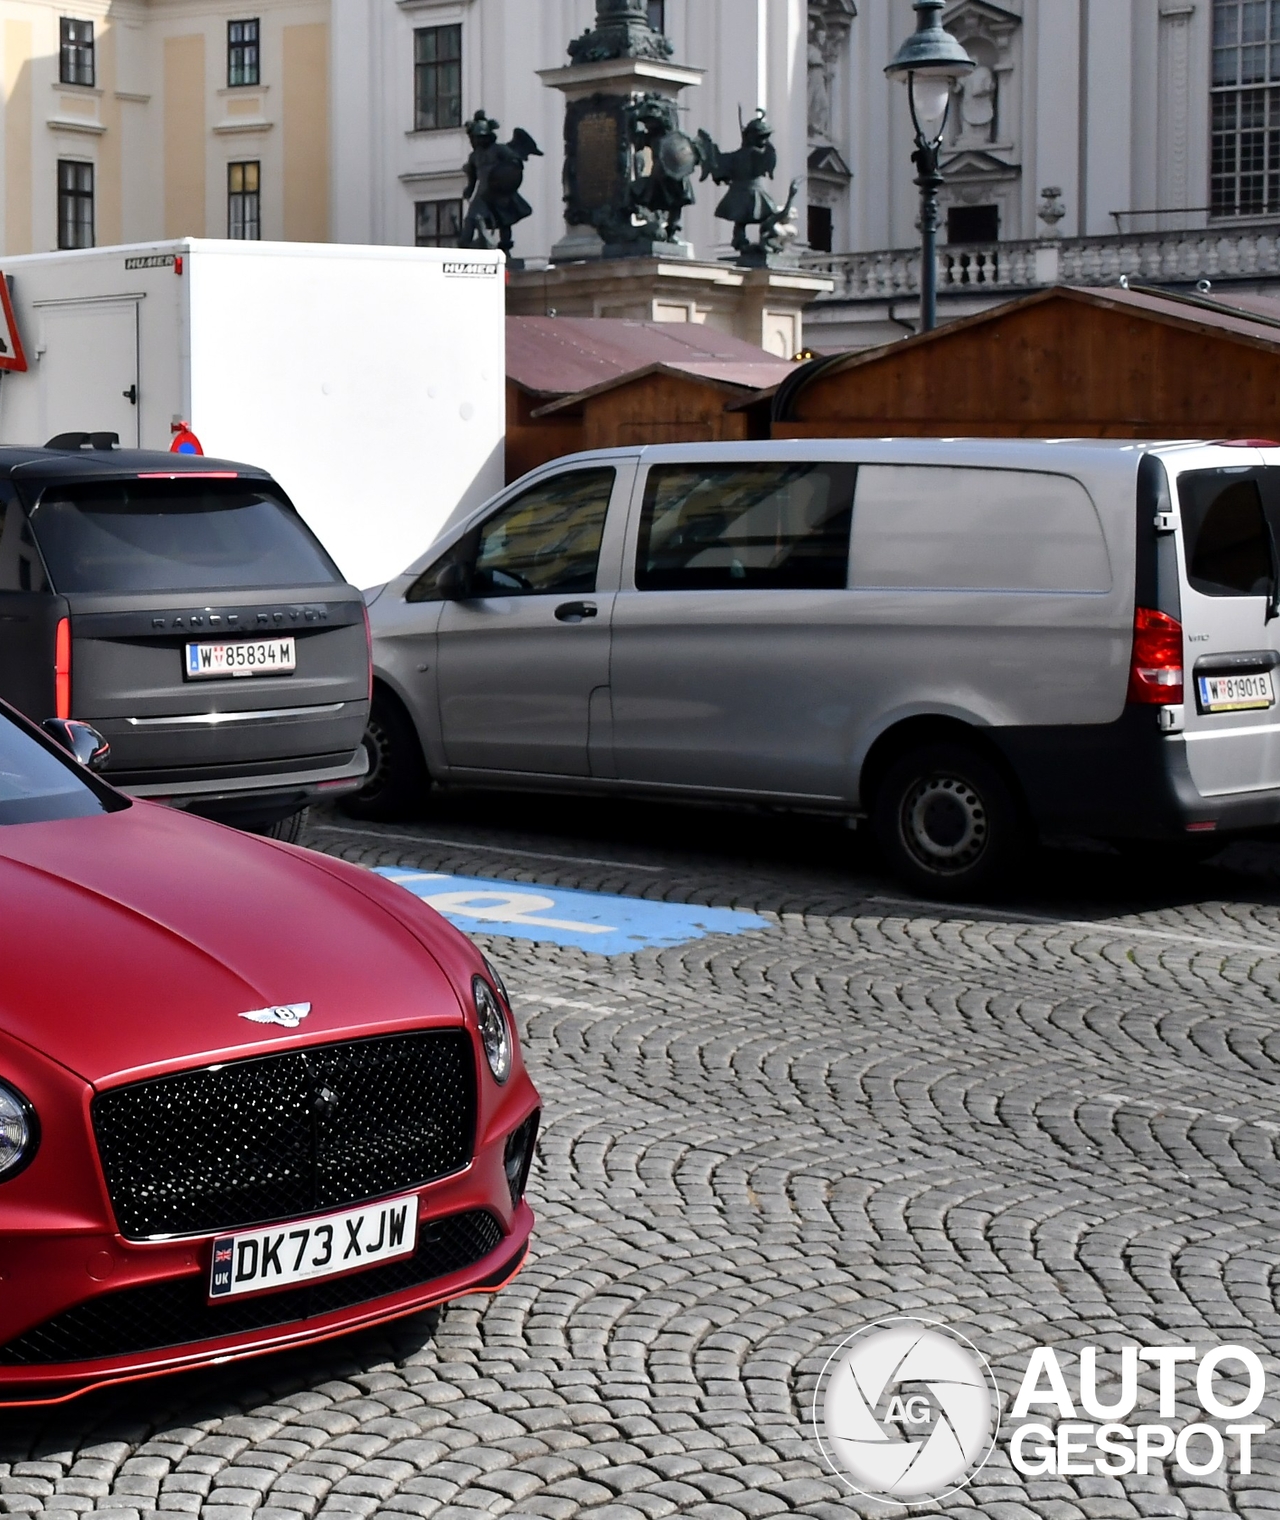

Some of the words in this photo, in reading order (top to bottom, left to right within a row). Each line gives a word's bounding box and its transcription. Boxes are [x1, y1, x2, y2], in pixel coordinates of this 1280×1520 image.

[127, 256, 174, 268] HUMER
[444, 263, 497, 274] HUMER
[152, 614, 239, 630] RANGE
[256, 611, 328, 624] ROVER
[200, 648, 212, 668] W
[225, 644, 276, 667] 85834
[280, 643, 290, 663] M
[1209, 680, 1219, 699] W
[235, 1224, 334, 1283] DK73
[343, 1205, 408, 1260] XJW
[215, 1271, 229, 1286] UK
